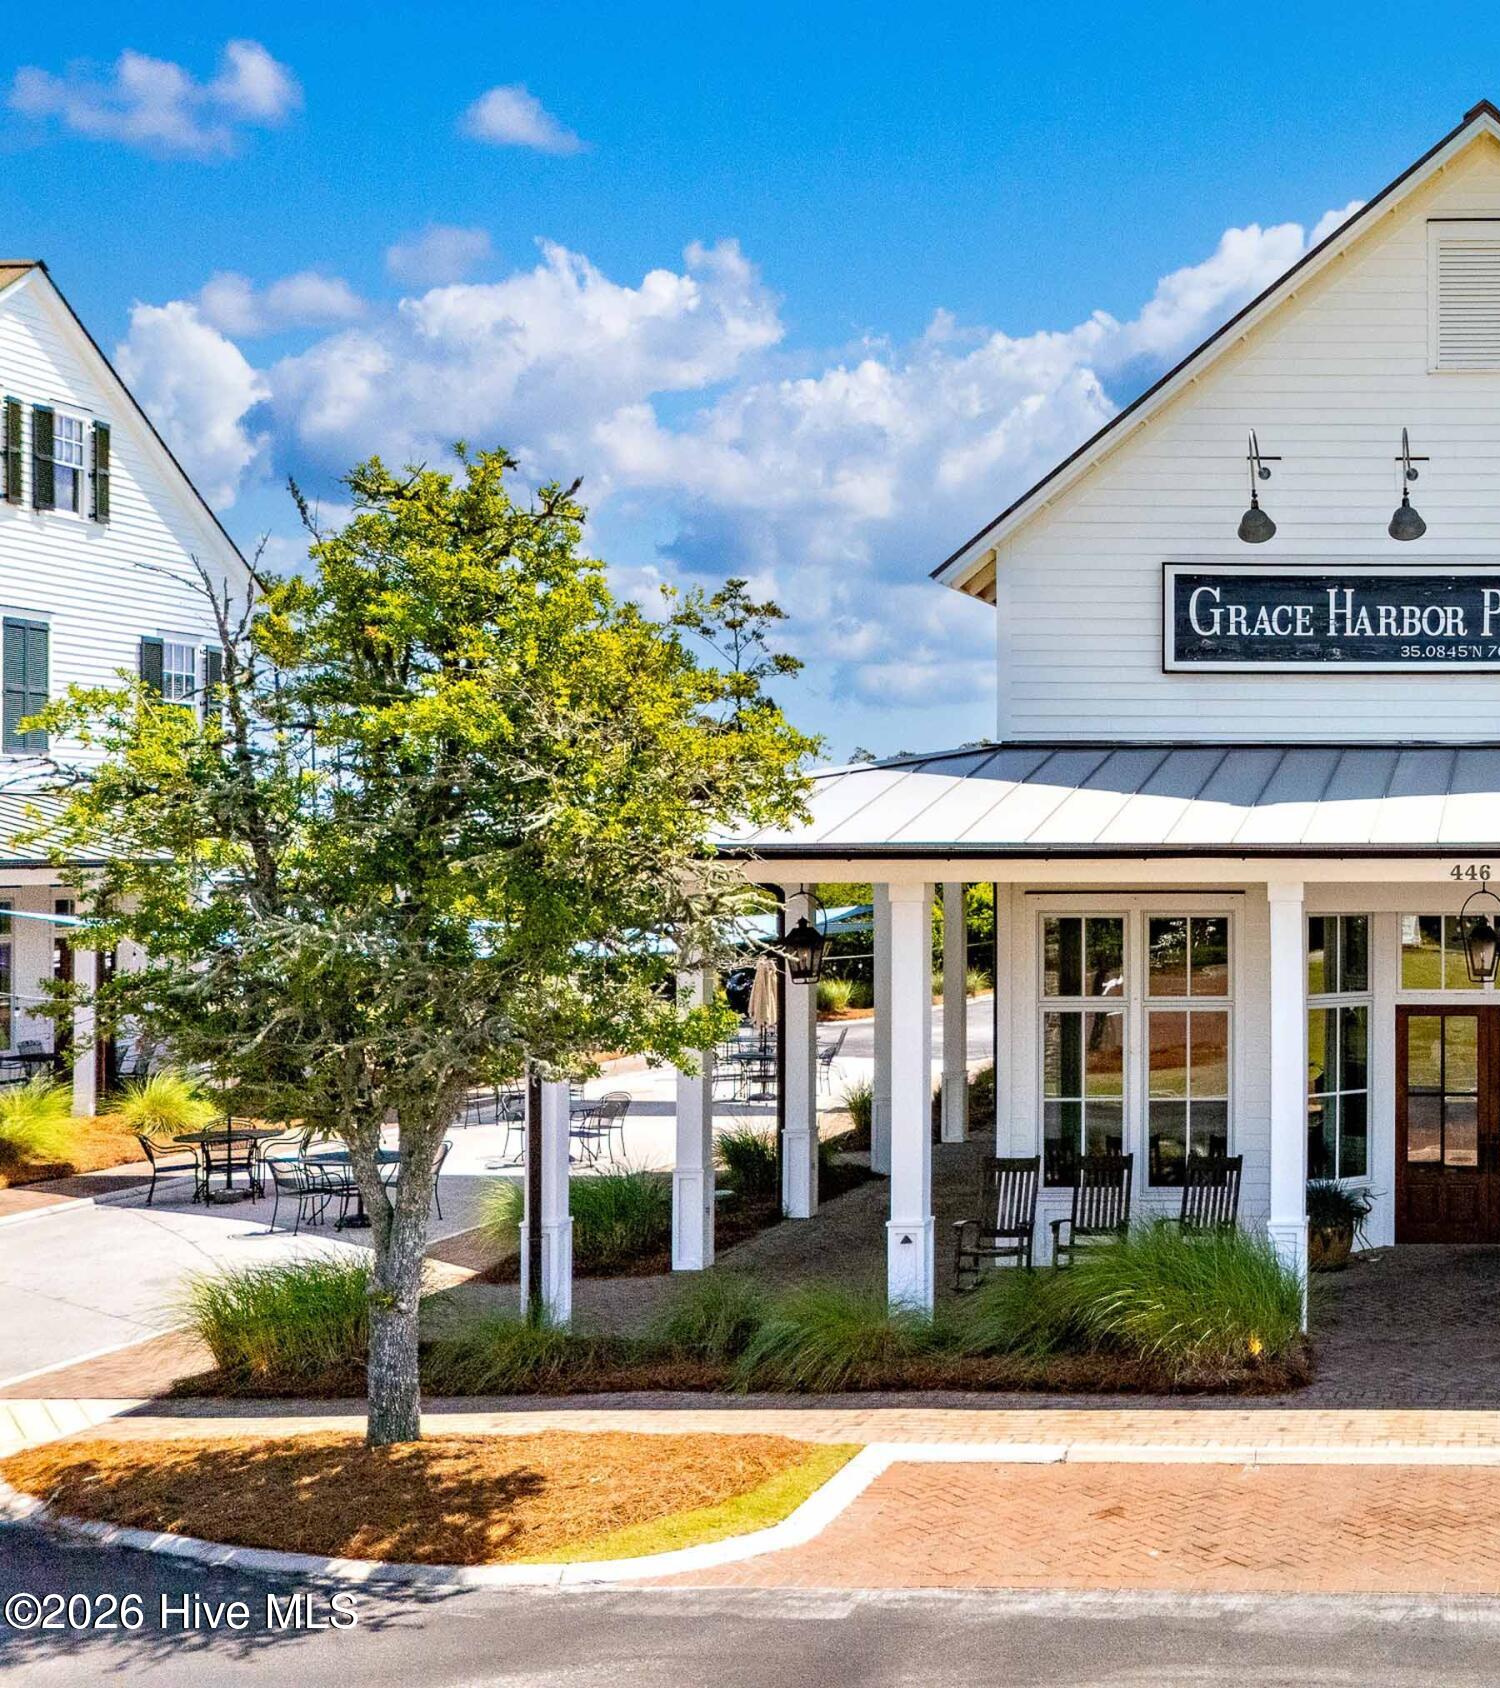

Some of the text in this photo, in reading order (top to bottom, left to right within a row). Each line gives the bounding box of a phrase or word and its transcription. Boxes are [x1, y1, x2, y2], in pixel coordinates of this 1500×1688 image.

[1188, 586, 1314, 637] GRACE
[1326, 587, 1468, 637] HARBOR
[1450, 864, 1491, 881] 446
